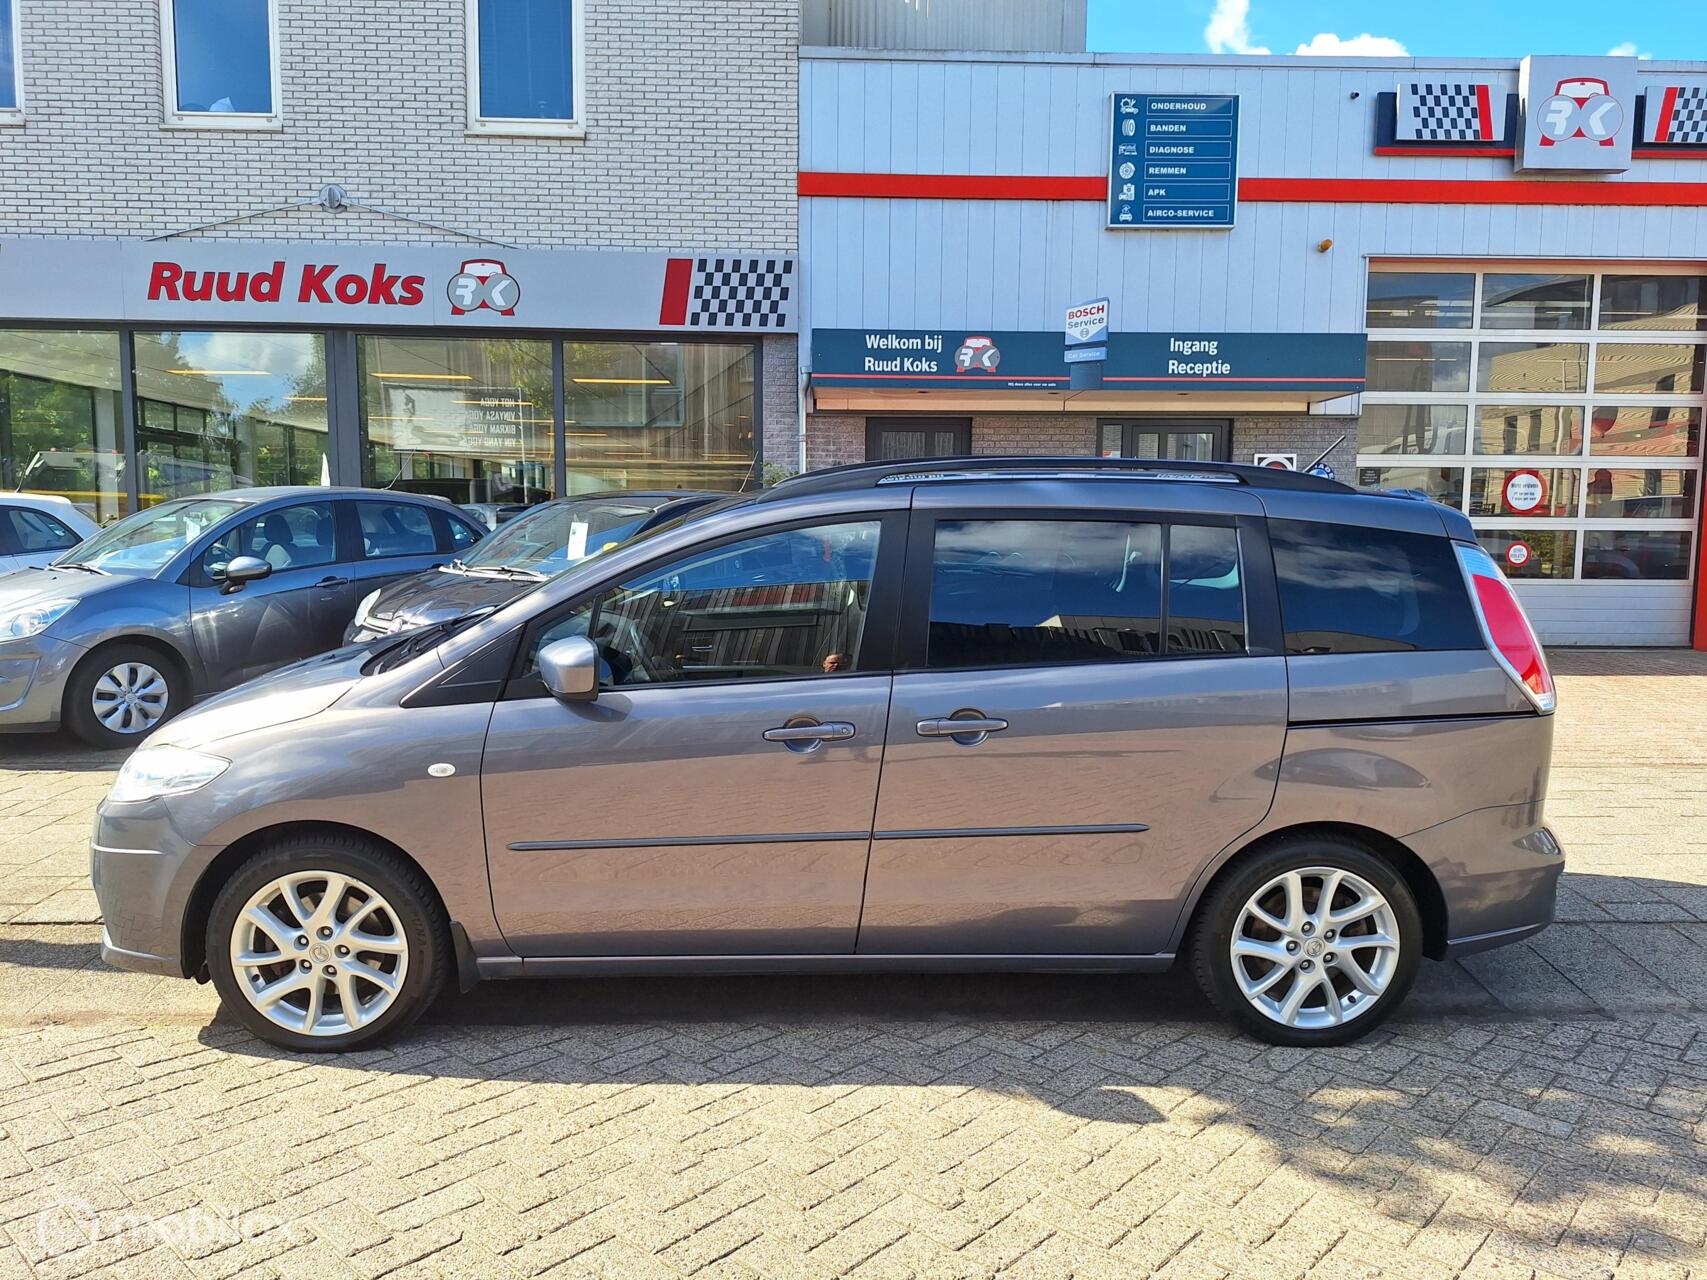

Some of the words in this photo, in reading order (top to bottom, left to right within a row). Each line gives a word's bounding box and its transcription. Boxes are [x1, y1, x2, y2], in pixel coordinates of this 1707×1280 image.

[1151, 102, 1207, 110] ONDERHOUD
[1149, 146, 1195, 154] DIAGNOSE
[1147, 209, 1215, 217] AIRCO-SERVICE
[147, 261, 286, 302] Ruud
[298, 263, 425, 306] Koks
[1068, 304, 1105, 320] BOSCH
[1067, 317, 1105, 329] Service
[865, 334, 922, 350] Welkom
[925, 335, 942, 353] bij
[1170, 337, 1218, 355] Ingang
[864, 357, 901, 372] Ruud
[903, 357, 938, 373] Koks
[1168, 360, 1231, 377] Receptie
